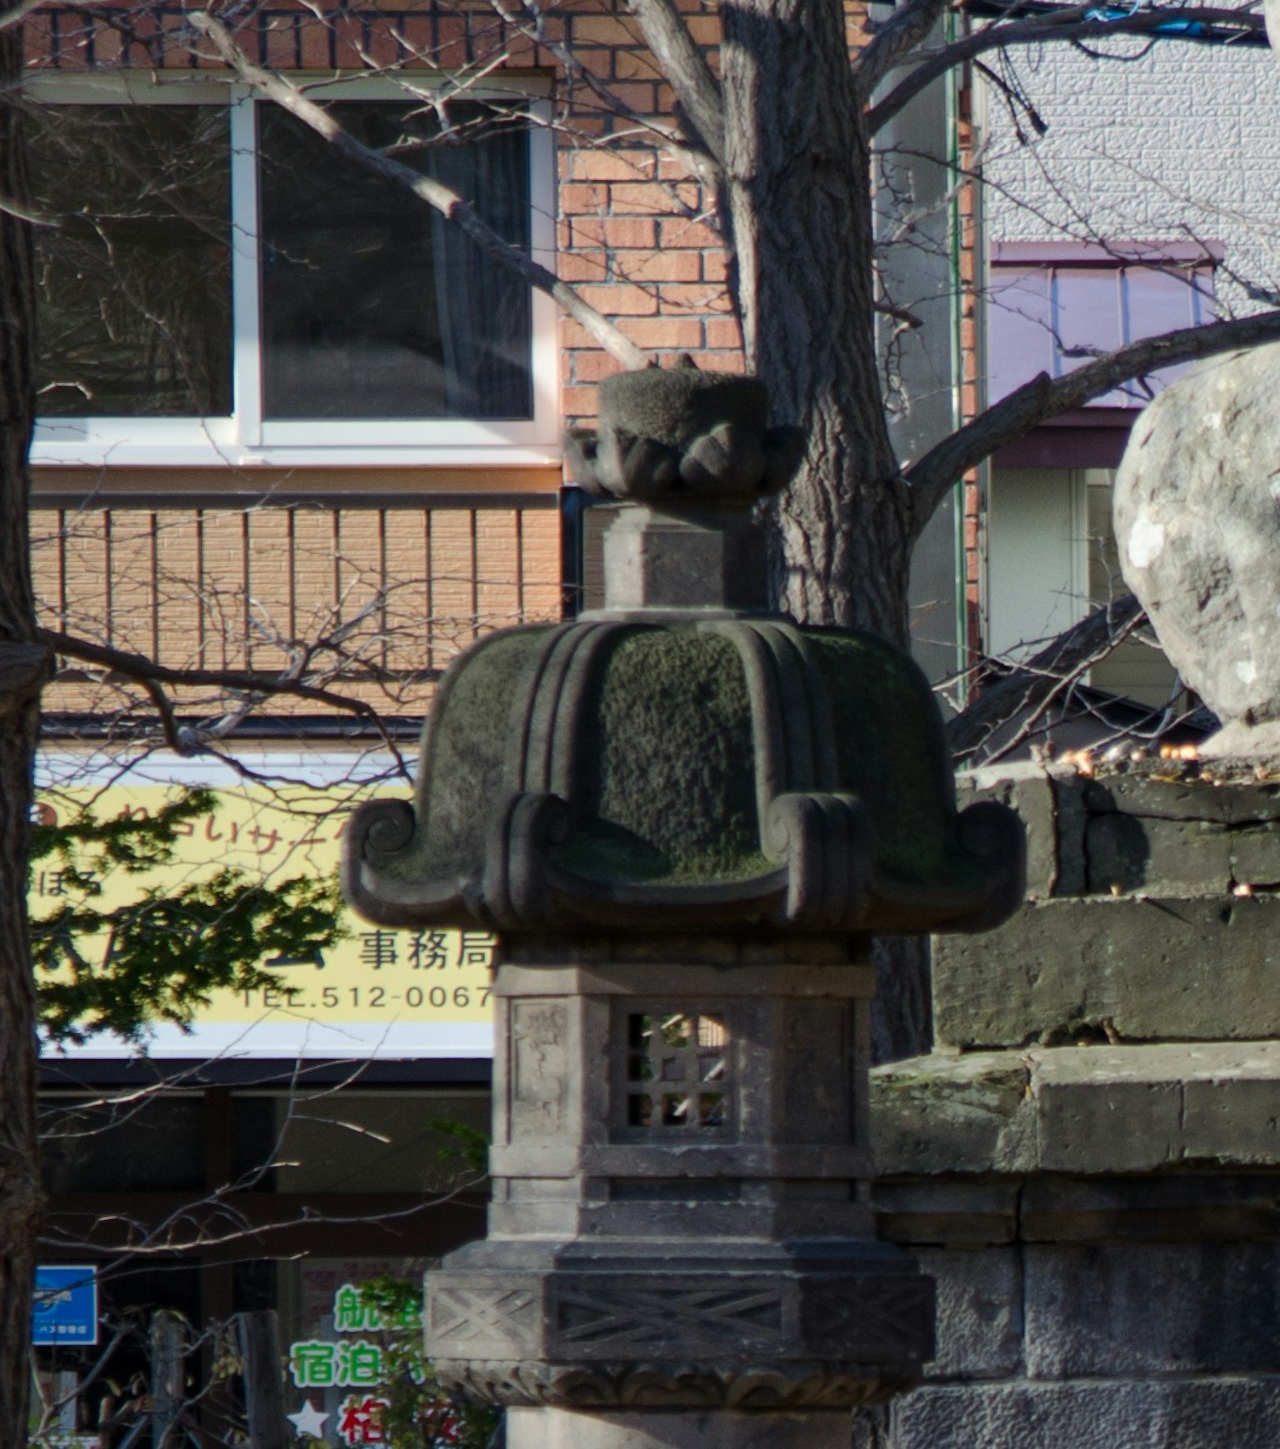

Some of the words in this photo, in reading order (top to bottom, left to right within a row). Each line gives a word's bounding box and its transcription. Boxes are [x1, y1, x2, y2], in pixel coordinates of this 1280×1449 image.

[358, 928, 495, 970] 事務局
[240, 986, 492, 1009] TEL.512-0067
[290, 1339, 426, 1387] 宿泊
